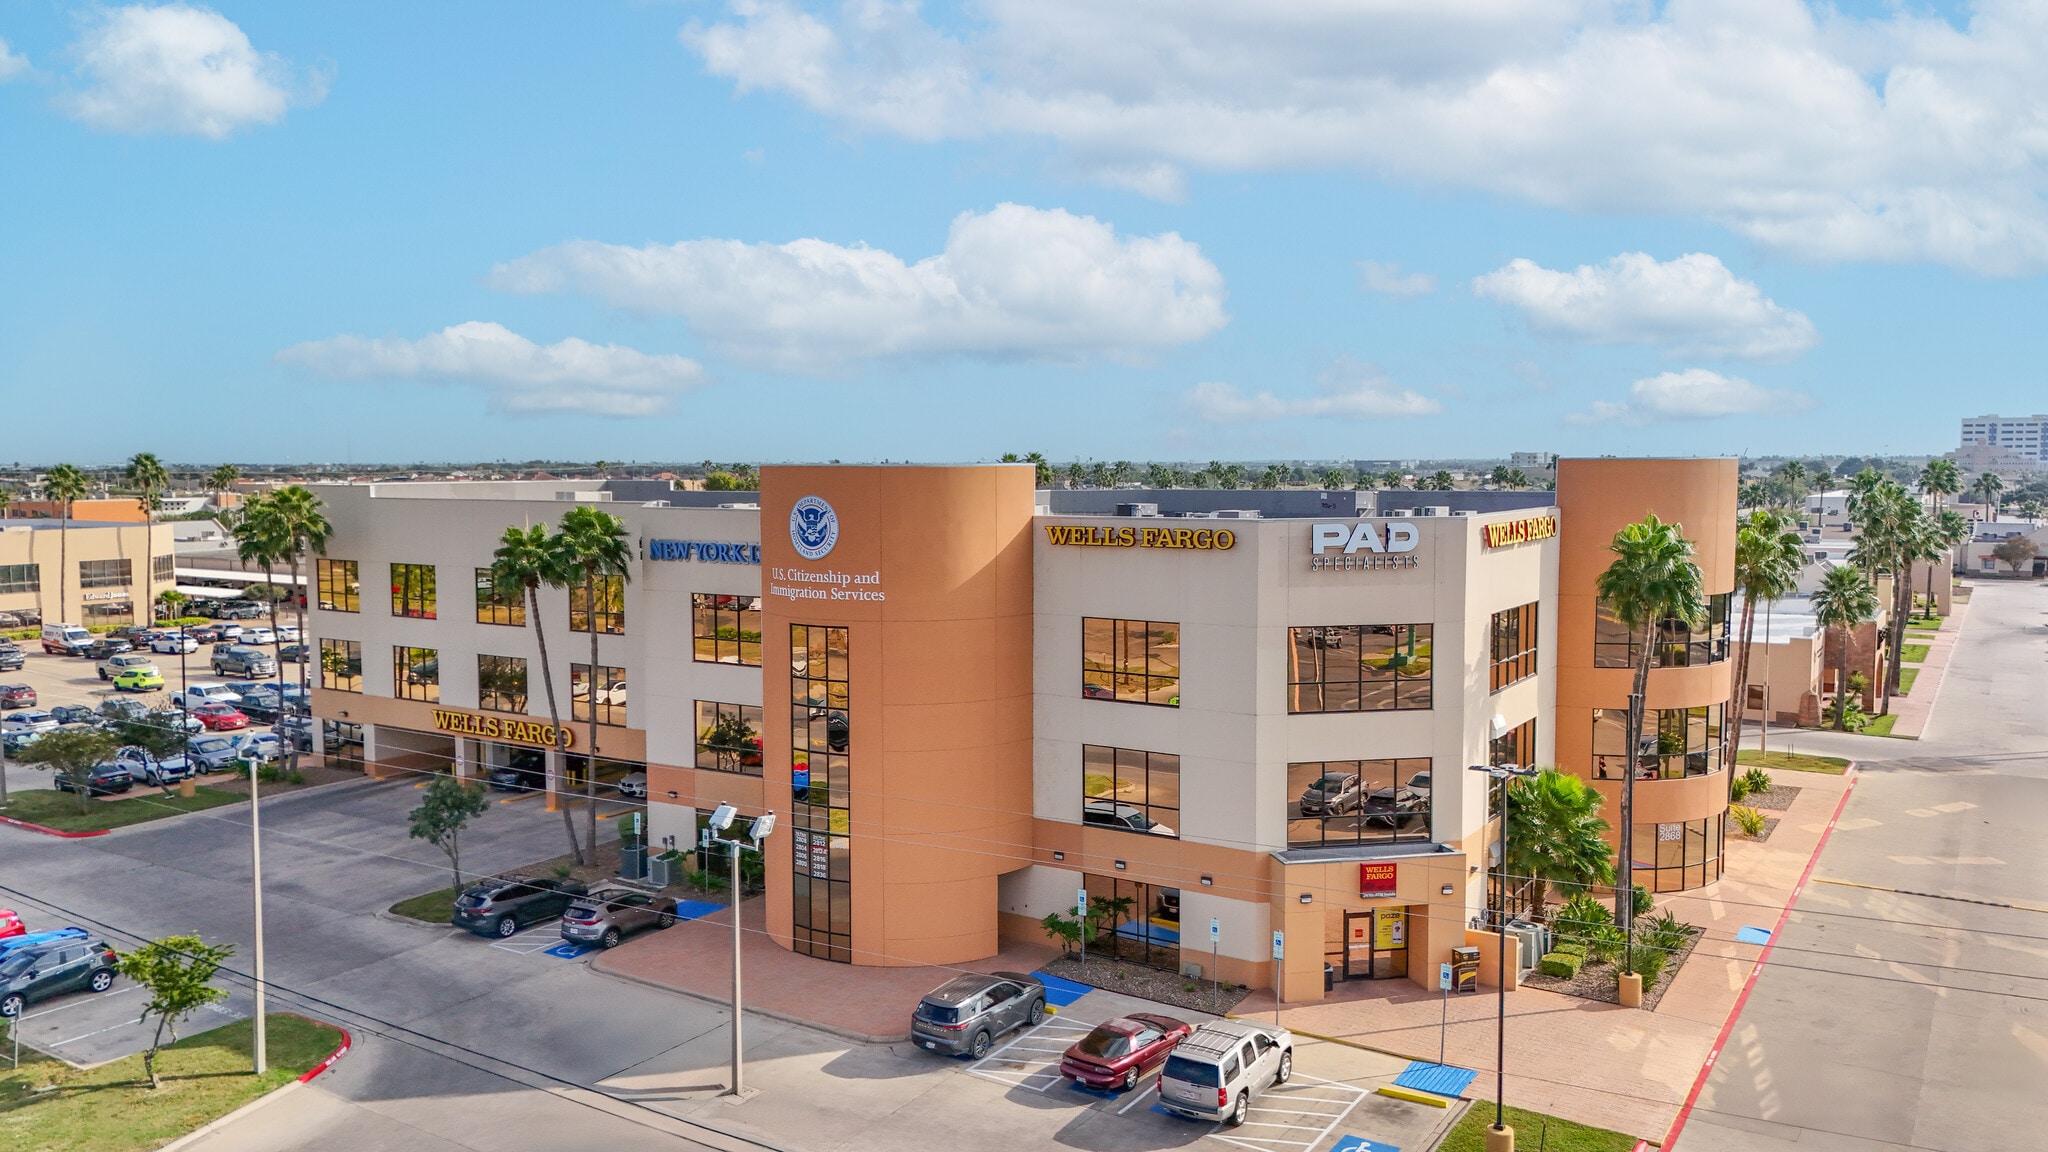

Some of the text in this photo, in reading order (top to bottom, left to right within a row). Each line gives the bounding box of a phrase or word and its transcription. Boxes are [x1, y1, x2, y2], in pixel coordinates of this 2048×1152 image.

[797, 498, 831, 514] DEPARTMENT
[791, 529, 837, 557] HOMELAND SECURITY
[1045, 526, 1236, 550] WELLS FARGO
[1312, 523, 1420, 554] PAD
[1487, 515, 1557, 548] WELLS FARGO
[650, 539, 691, 561] NEW
[691, 542, 748, 564] YORK
[1312, 556, 1419, 572] SPECIALISTS
[772, 568, 880, 588] U.S. Citizenship and
[770, 583, 885, 601] Immigration Services
[431, 709, 575, 748] WELLS FARGO
